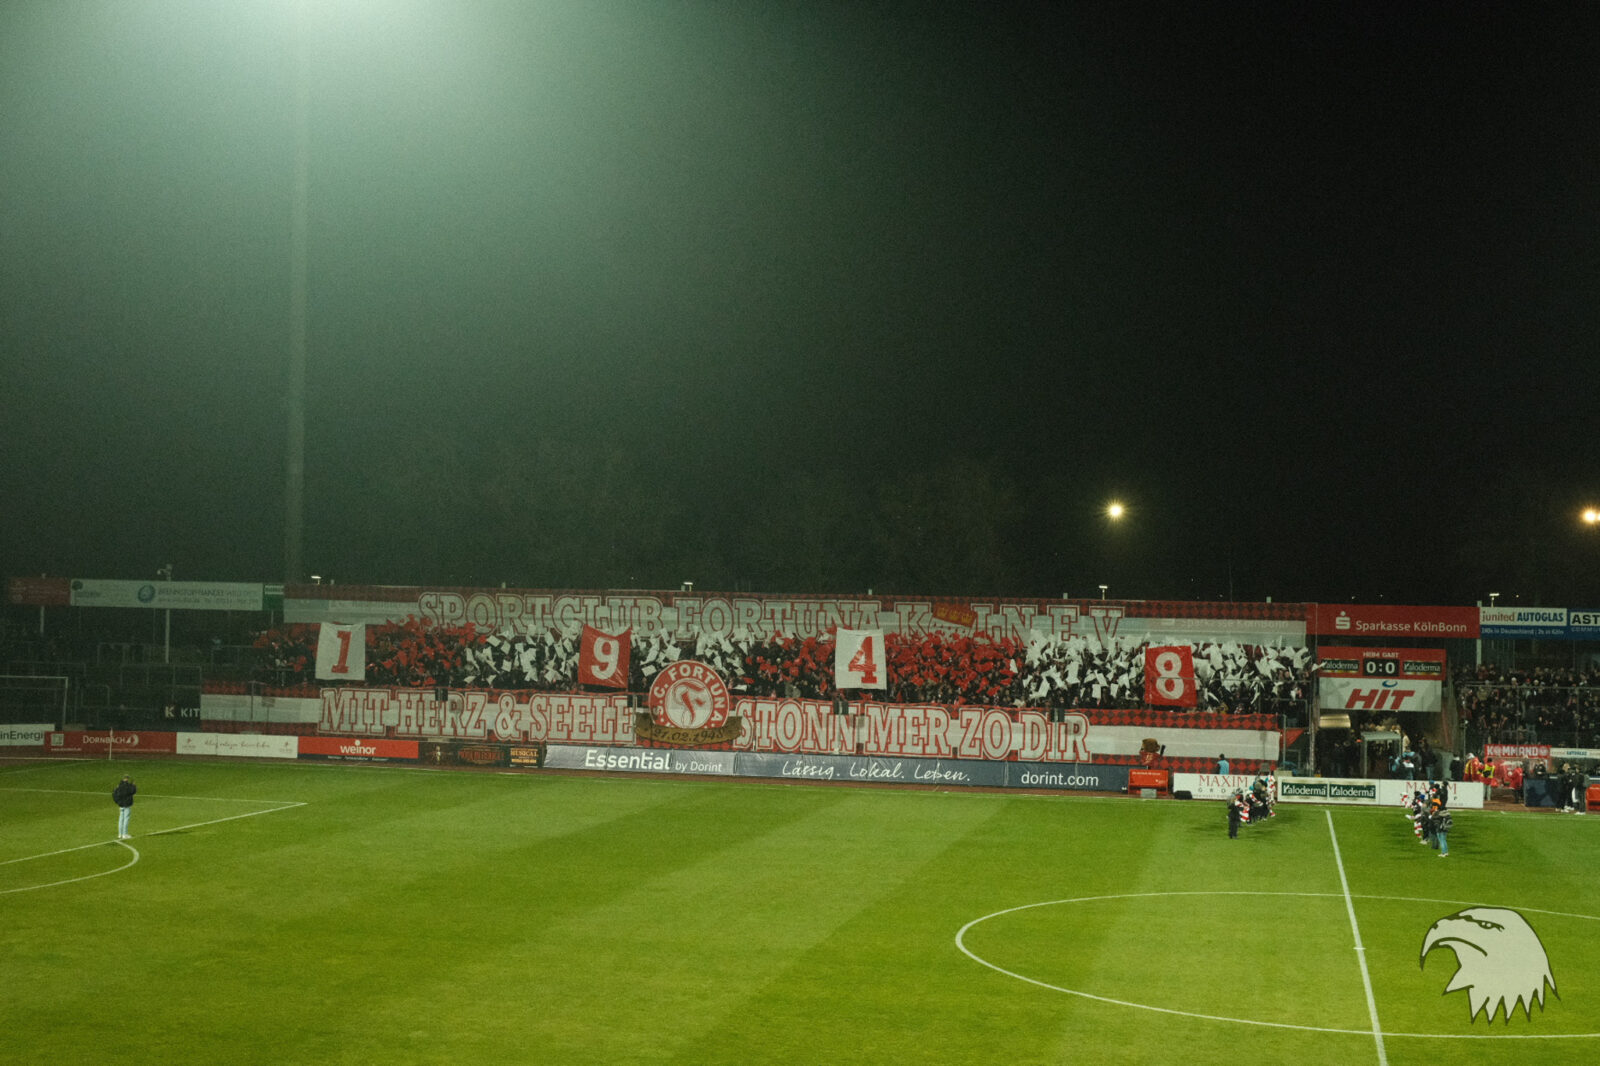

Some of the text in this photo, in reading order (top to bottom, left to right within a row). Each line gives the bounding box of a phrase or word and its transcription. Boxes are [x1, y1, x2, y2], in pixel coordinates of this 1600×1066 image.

[419, 592, 664, 640] SPORTCLUB
[673, 597, 882, 643] FORTUNA
[894, 602, 1038, 649] KLN
[1355, 620, 1467, 632] Sparkasse KölnBonn
[1482, 611, 1564, 622] junited AUTOGLAS
[331, 630, 352, 674] 1
[591, 637, 620, 680] 9
[848, 636, 877, 684] 4
[1155, 651, 1185, 700] 8
[668, 664, 726, 722] FORTUNA
[1344, 688, 1416, 710] HIT
[317, 687, 392, 736] MIT
[395, 689, 488, 739] HERZ
[494, 692, 523, 741] &
[529, 693, 637, 745] SEELE
[957, 707, 1012, 761] ZO
[1018, 711, 1091, 763] DIR
[82, 735, 126, 745] DORNBACH
[340, 740, 376, 755] weinor
[585, 750, 722, 773] Essential by Dorint
[782, 760, 970, 782] Lässig. Lokal. Leben.
[1021, 772, 1099, 786] dorint.com
[1199, 774, 1248, 788] MAXIM
[1283, 784, 1327, 795] Kaloderma
[1330, 786, 1376, 797] Kaloderma
